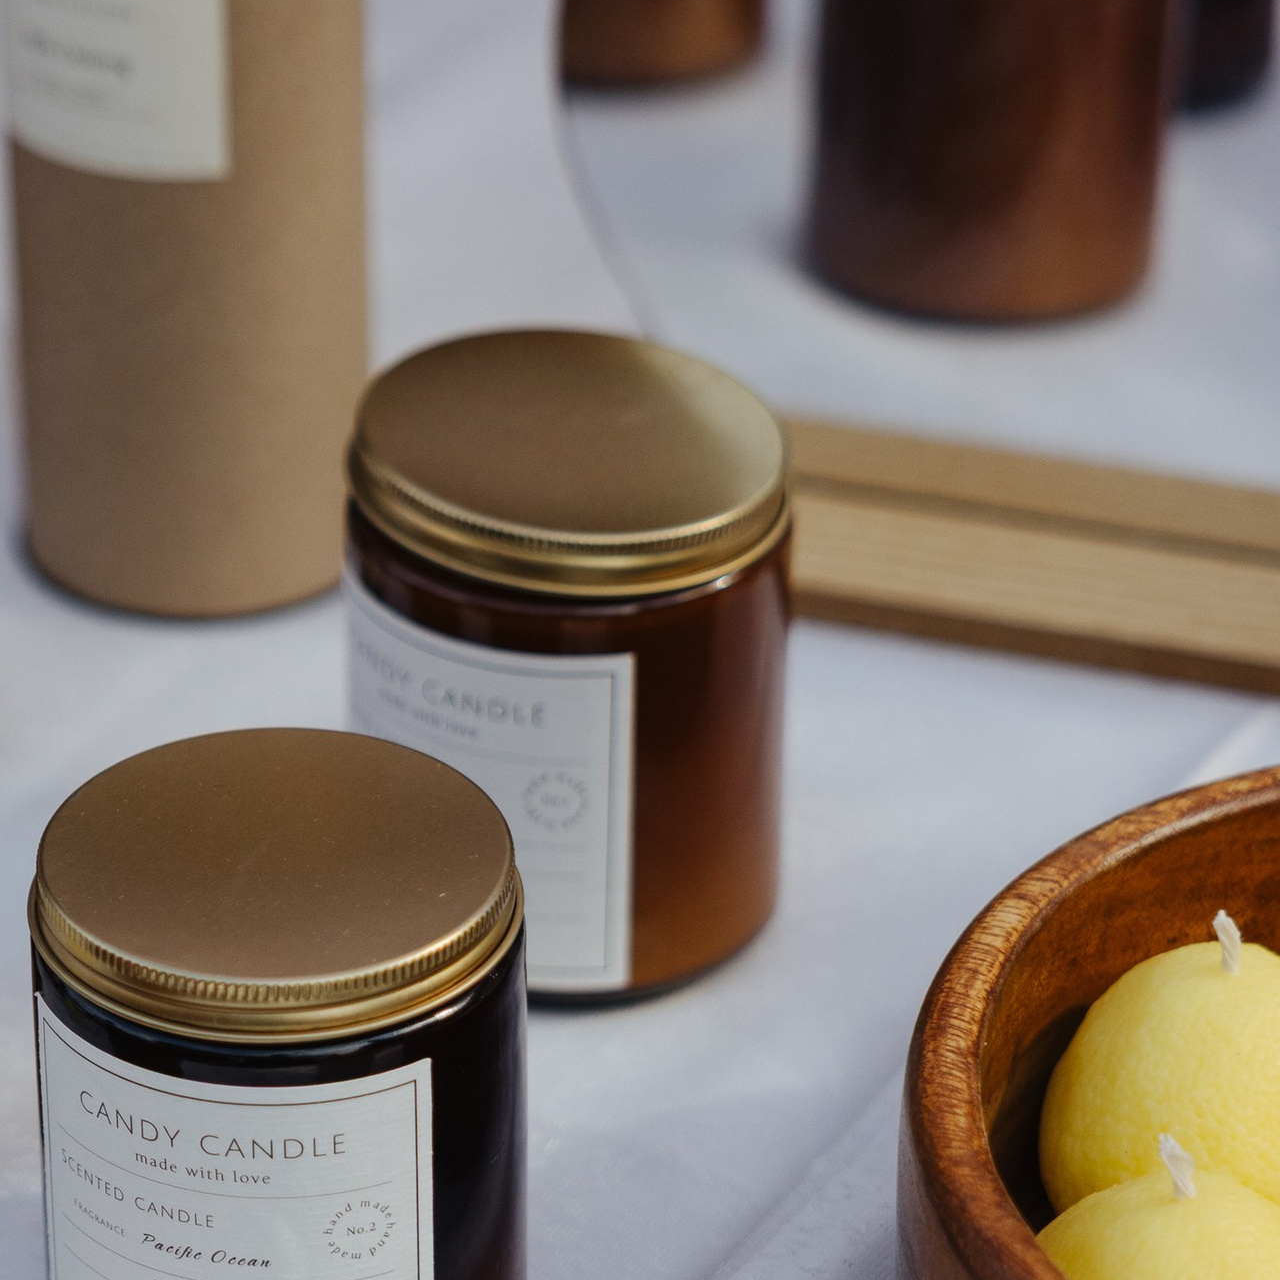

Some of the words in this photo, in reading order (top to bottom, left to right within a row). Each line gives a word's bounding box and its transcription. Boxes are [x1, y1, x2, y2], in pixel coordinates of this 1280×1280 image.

[421, 676, 546, 729] CANDLE
[79, 1090, 181, 1148] CANDY
[199, 1133, 347, 1160] CANDLE
[61, 1148, 125, 1201] SCENTED
[134, 1196, 215, 1229] CANDLE
[134, 1152, 178, 1173] made
[185, 1167, 225, 1182] with
[233, 1170, 271, 1185] love
[73, 1197, 126, 1237] FRAGRANCE
[141, 1232, 202, 1260] Pacific
[210, 1249, 272, 1268] Ocean
[322, 1202, 353, 1235] hand
[359, 1200, 393, 1219] made
